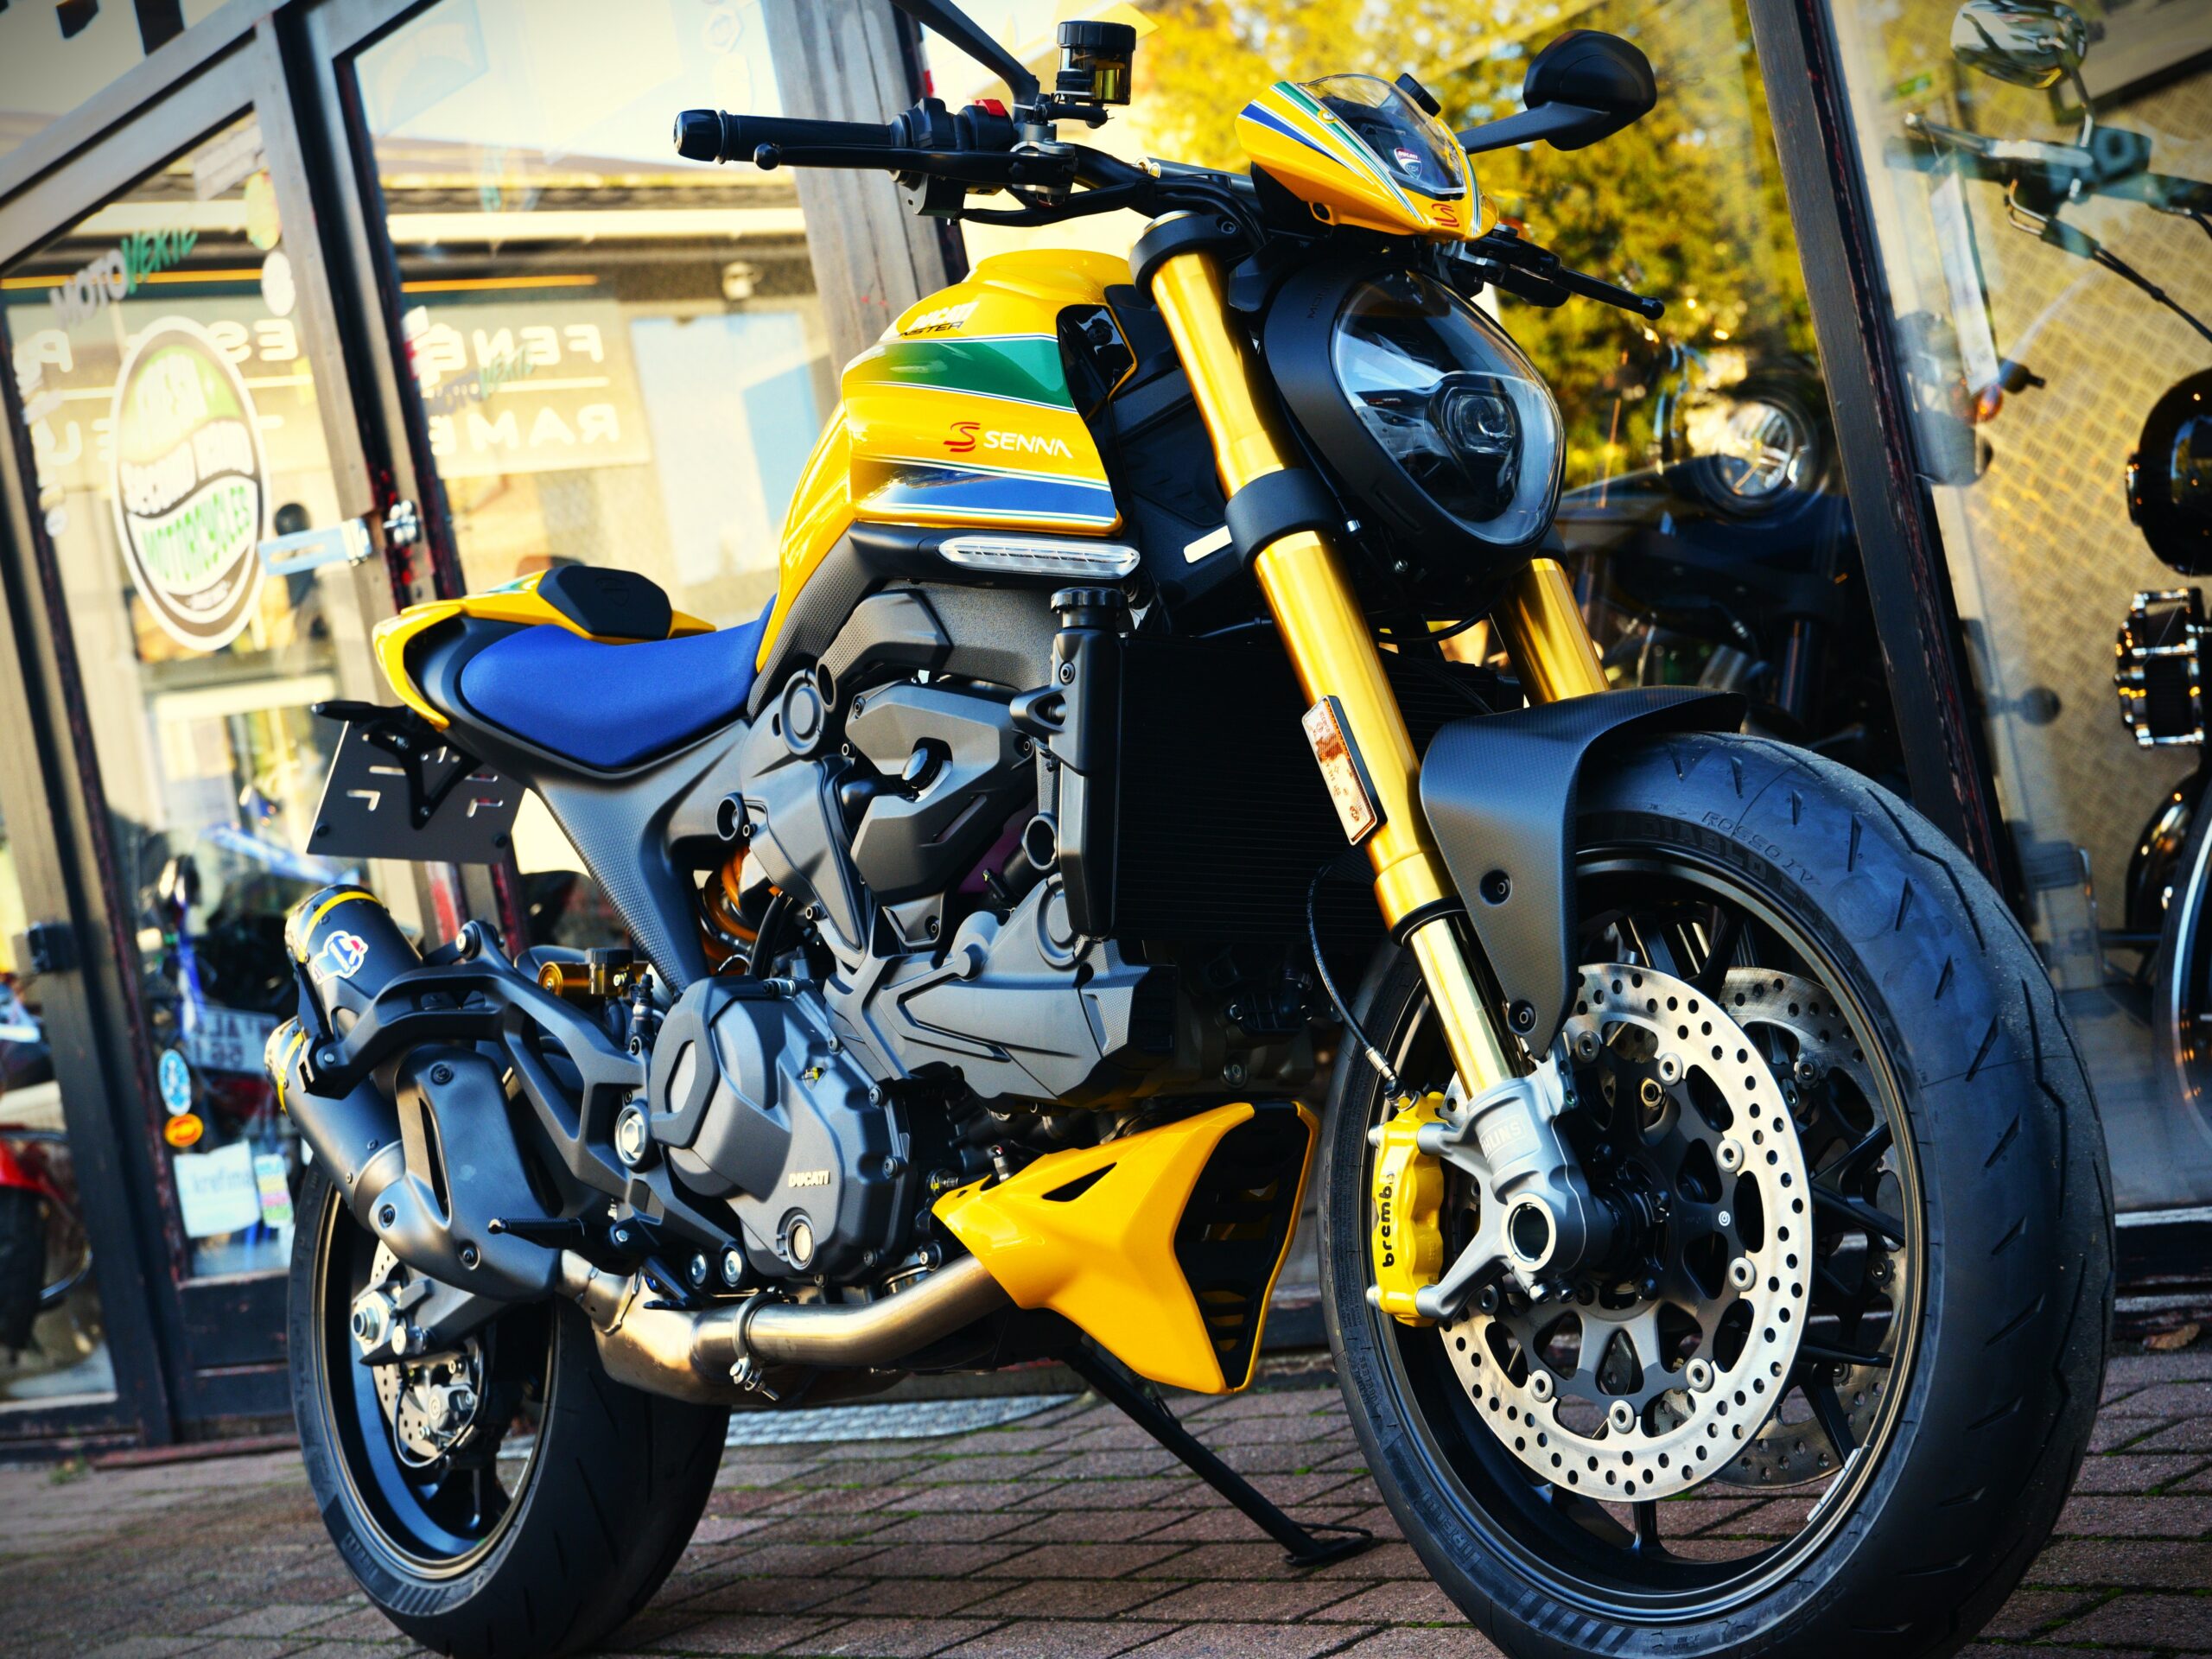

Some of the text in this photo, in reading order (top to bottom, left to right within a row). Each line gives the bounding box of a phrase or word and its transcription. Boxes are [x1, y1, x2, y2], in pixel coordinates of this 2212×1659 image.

[983, 430, 1074, 459] SENNA
[1701, 810, 1781, 861] ROSSO
[788, 1171, 830, 1188] DUCATI
